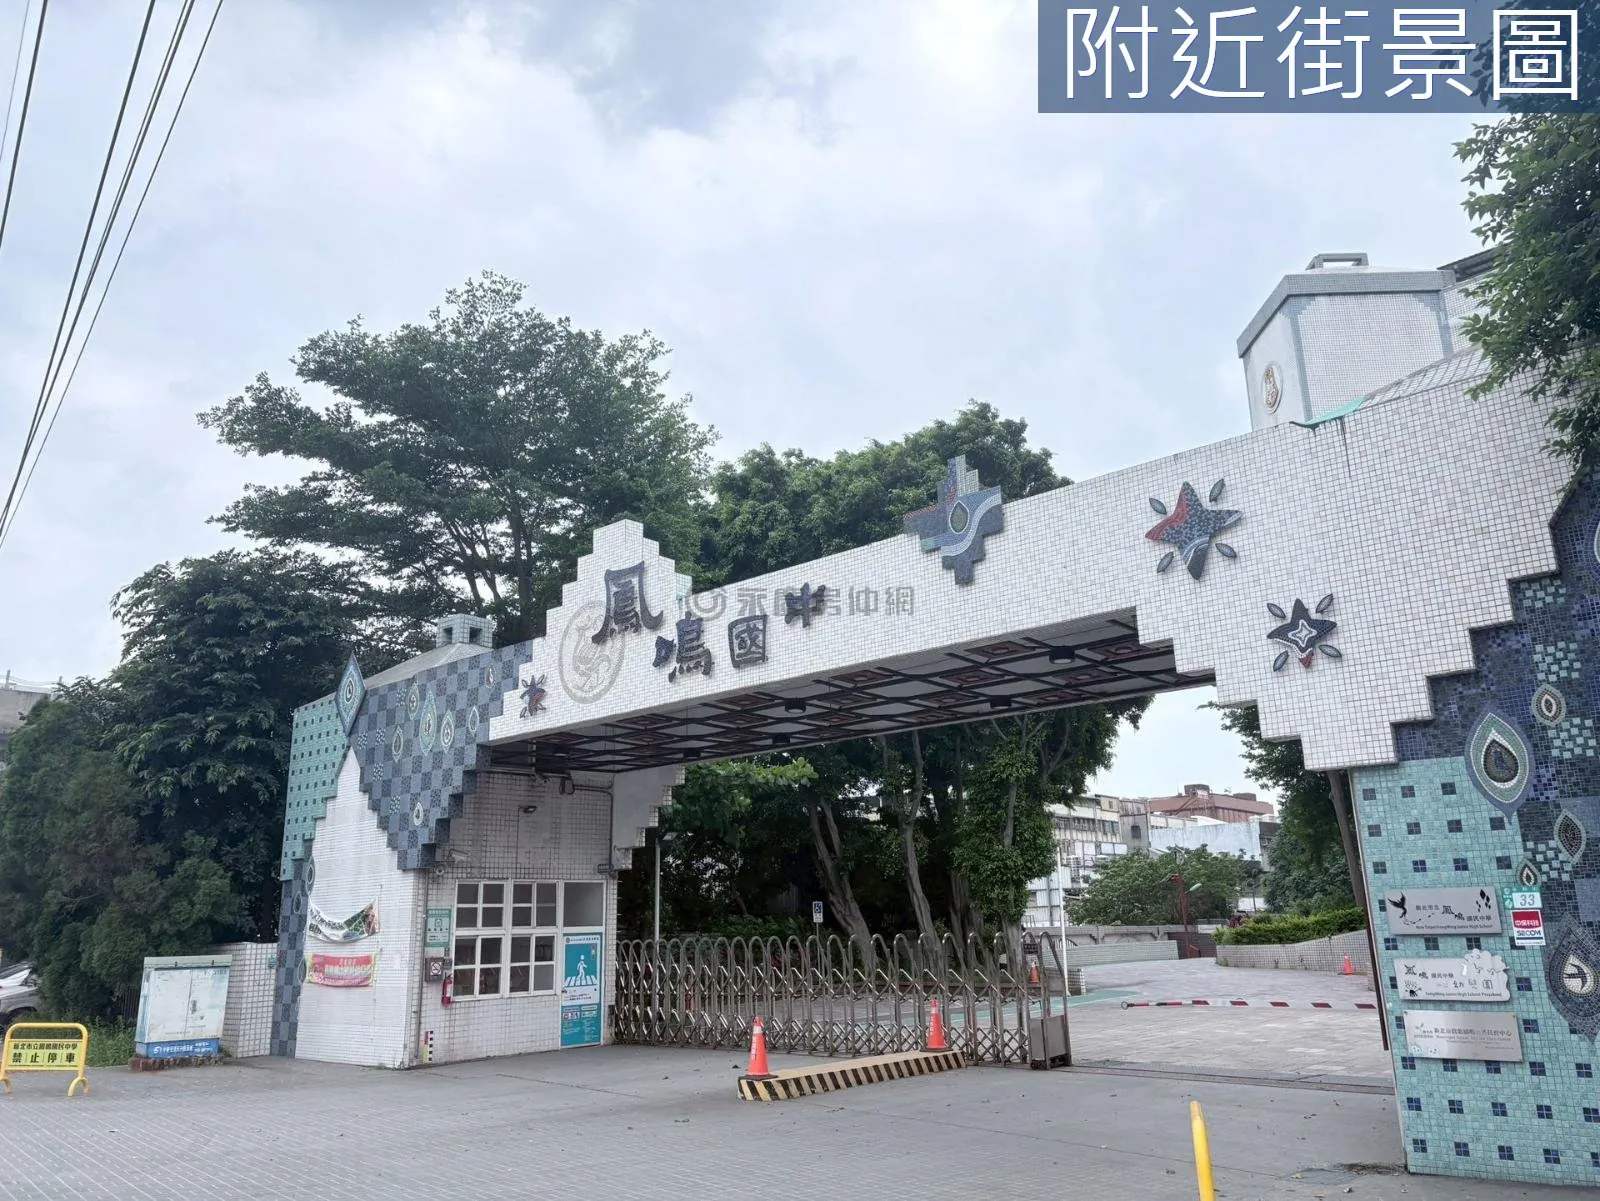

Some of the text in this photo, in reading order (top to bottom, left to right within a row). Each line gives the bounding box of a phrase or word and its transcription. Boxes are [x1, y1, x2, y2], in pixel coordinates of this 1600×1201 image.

[590, 560, 827, 684] 鳳鳴國中
[1519, 894, 1535, 907] 33
[1517, 929, 1542, 937] SECOM
[12, 1052, 76, 1063] 禁止停車
